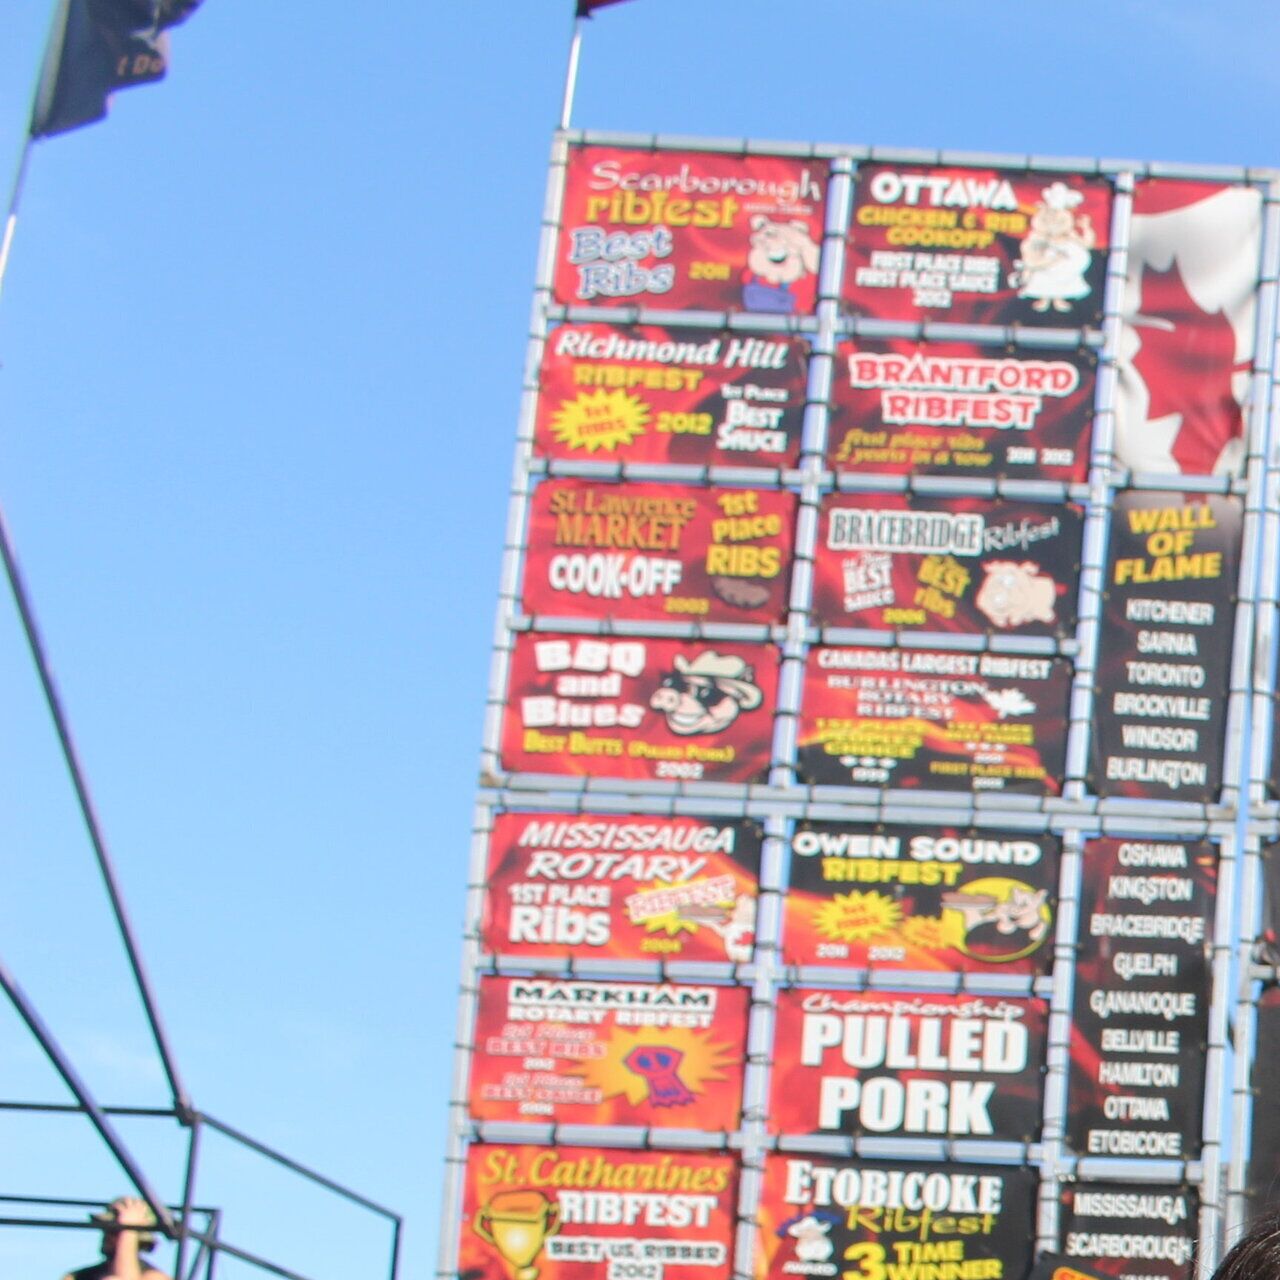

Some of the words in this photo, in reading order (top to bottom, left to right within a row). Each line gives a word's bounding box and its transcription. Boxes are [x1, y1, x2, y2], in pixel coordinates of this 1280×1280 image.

[588, 160, 821, 204] Scarborough
[870, 171, 1019, 210] OTTAWA
[586, 190, 740, 228] ribfest
[569, 225, 673, 264] Best
[577, 262, 675, 299] Ribs
[555, 330, 721, 366] Richmond
[724, 338, 789, 369] Hill
[574, 365, 704, 391] RIBFEST
[852, 355, 1077, 394] BRANTFORD
[655, 413, 713, 435] 2012
[885, 393, 1039, 426] RIBFEST
[585, 490, 697, 520] Lawrence
[1128, 504, 1216, 534] WALL
[554, 513, 690, 552] MARKET
[831, 509, 983, 554] BRACEBRIDGE
[1147, 531, 1195, 557] OF
[706, 544, 781, 578] RIBS
[1114, 552, 1221, 585] FLAME
[1126, 598, 1214, 626] KITCHENER
[1136, 631, 1198, 656] SARNIA
[557, 672, 623, 698] and
[1126, 660, 1206, 690] TORONTO
[521, 695, 646, 728] Blues
[1113, 692, 1211, 721] BROCKVILLE
[1122, 724, 1199, 752] WINDSOR
[1106, 756, 1208, 789] BURLINGTON
[519, 821, 735, 854] MISSISSAUGA
[793, 832, 900, 859] OWEN
[911, 837, 1042, 866] SOUND
[526, 851, 707, 882] ROTARY
[1118, 843, 1188, 868] OSHAWA
[822, 858, 963, 886] RIBFEST
[508, 883, 546, 905] 1ST
[549, 884, 611, 908] PLACE
[1108, 876, 1194, 905] KINGSTON
[508, 904, 611, 946] Ribs
[1090, 913, 1206, 945] BRACEBRIDGE
[1113, 953, 1178, 981] GUELPH
[510, 982, 714, 1011] MARKHAM
[802, 993, 1026, 1026] Championship
[1089, 990, 1196, 1020] GANANOQUE
[508, 1005, 609, 1024] ROTARY
[801, 1013, 1029, 1074] PULLED
[1098, 1061, 1179, 1087] HAMILTON
[819, 1076, 997, 1135] PORK
[1104, 1096, 1170, 1121] OTTAWA
[1088, 1132, 1182, 1157] ETOBICOKE
[482, 1150, 525, 1186] St.
[528, 1151, 731, 1194] Catharines
[786, 1160, 1003, 1214] ETOBICOKE
[557, 1190, 718, 1228] RIBFEST
[845, 1204, 998, 1240] Ribfest
[1073, 1192, 1187, 1224] MISSISSAUGA
[893, 1240, 965, 1264] TIME
[1066, 1234, 1192, 1265] SCARBOROUGH
